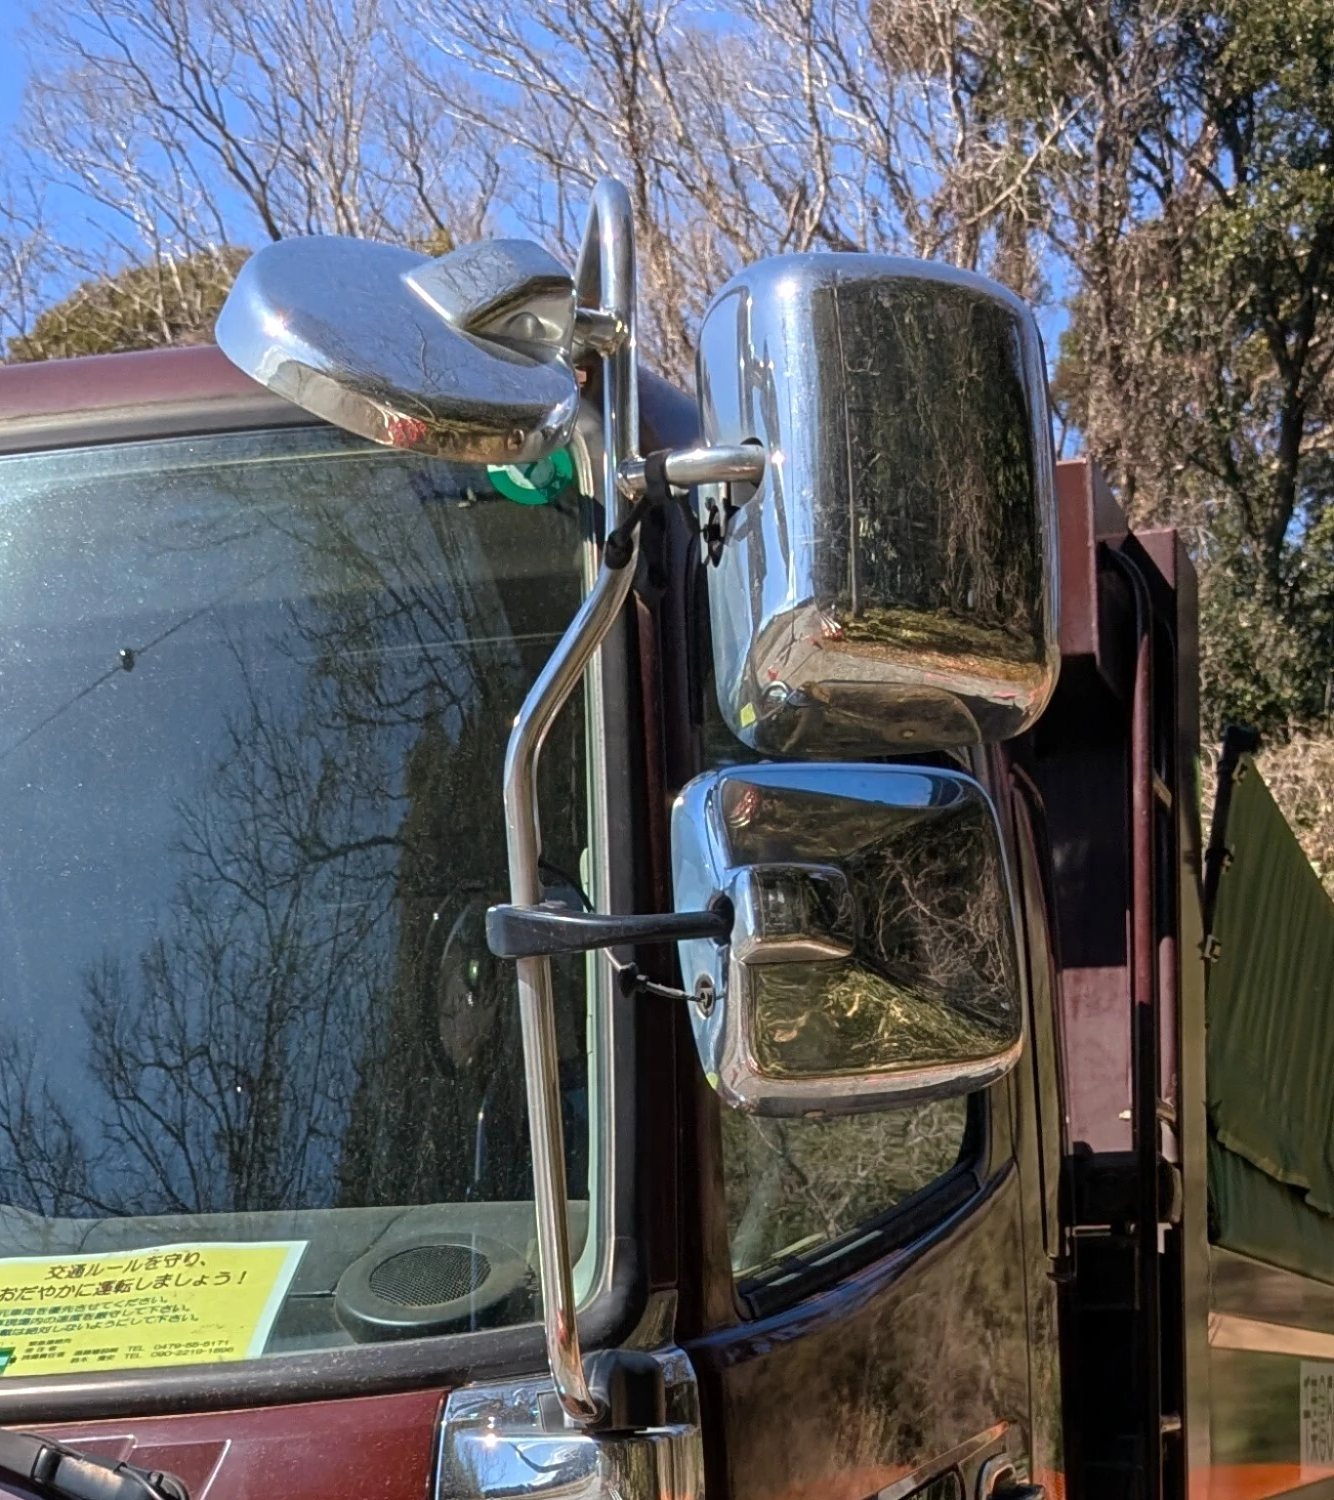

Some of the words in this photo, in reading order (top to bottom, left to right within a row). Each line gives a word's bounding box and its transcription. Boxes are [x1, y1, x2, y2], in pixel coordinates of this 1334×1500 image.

[44, 1251, 207, 1280] 交通ルールを守り、
